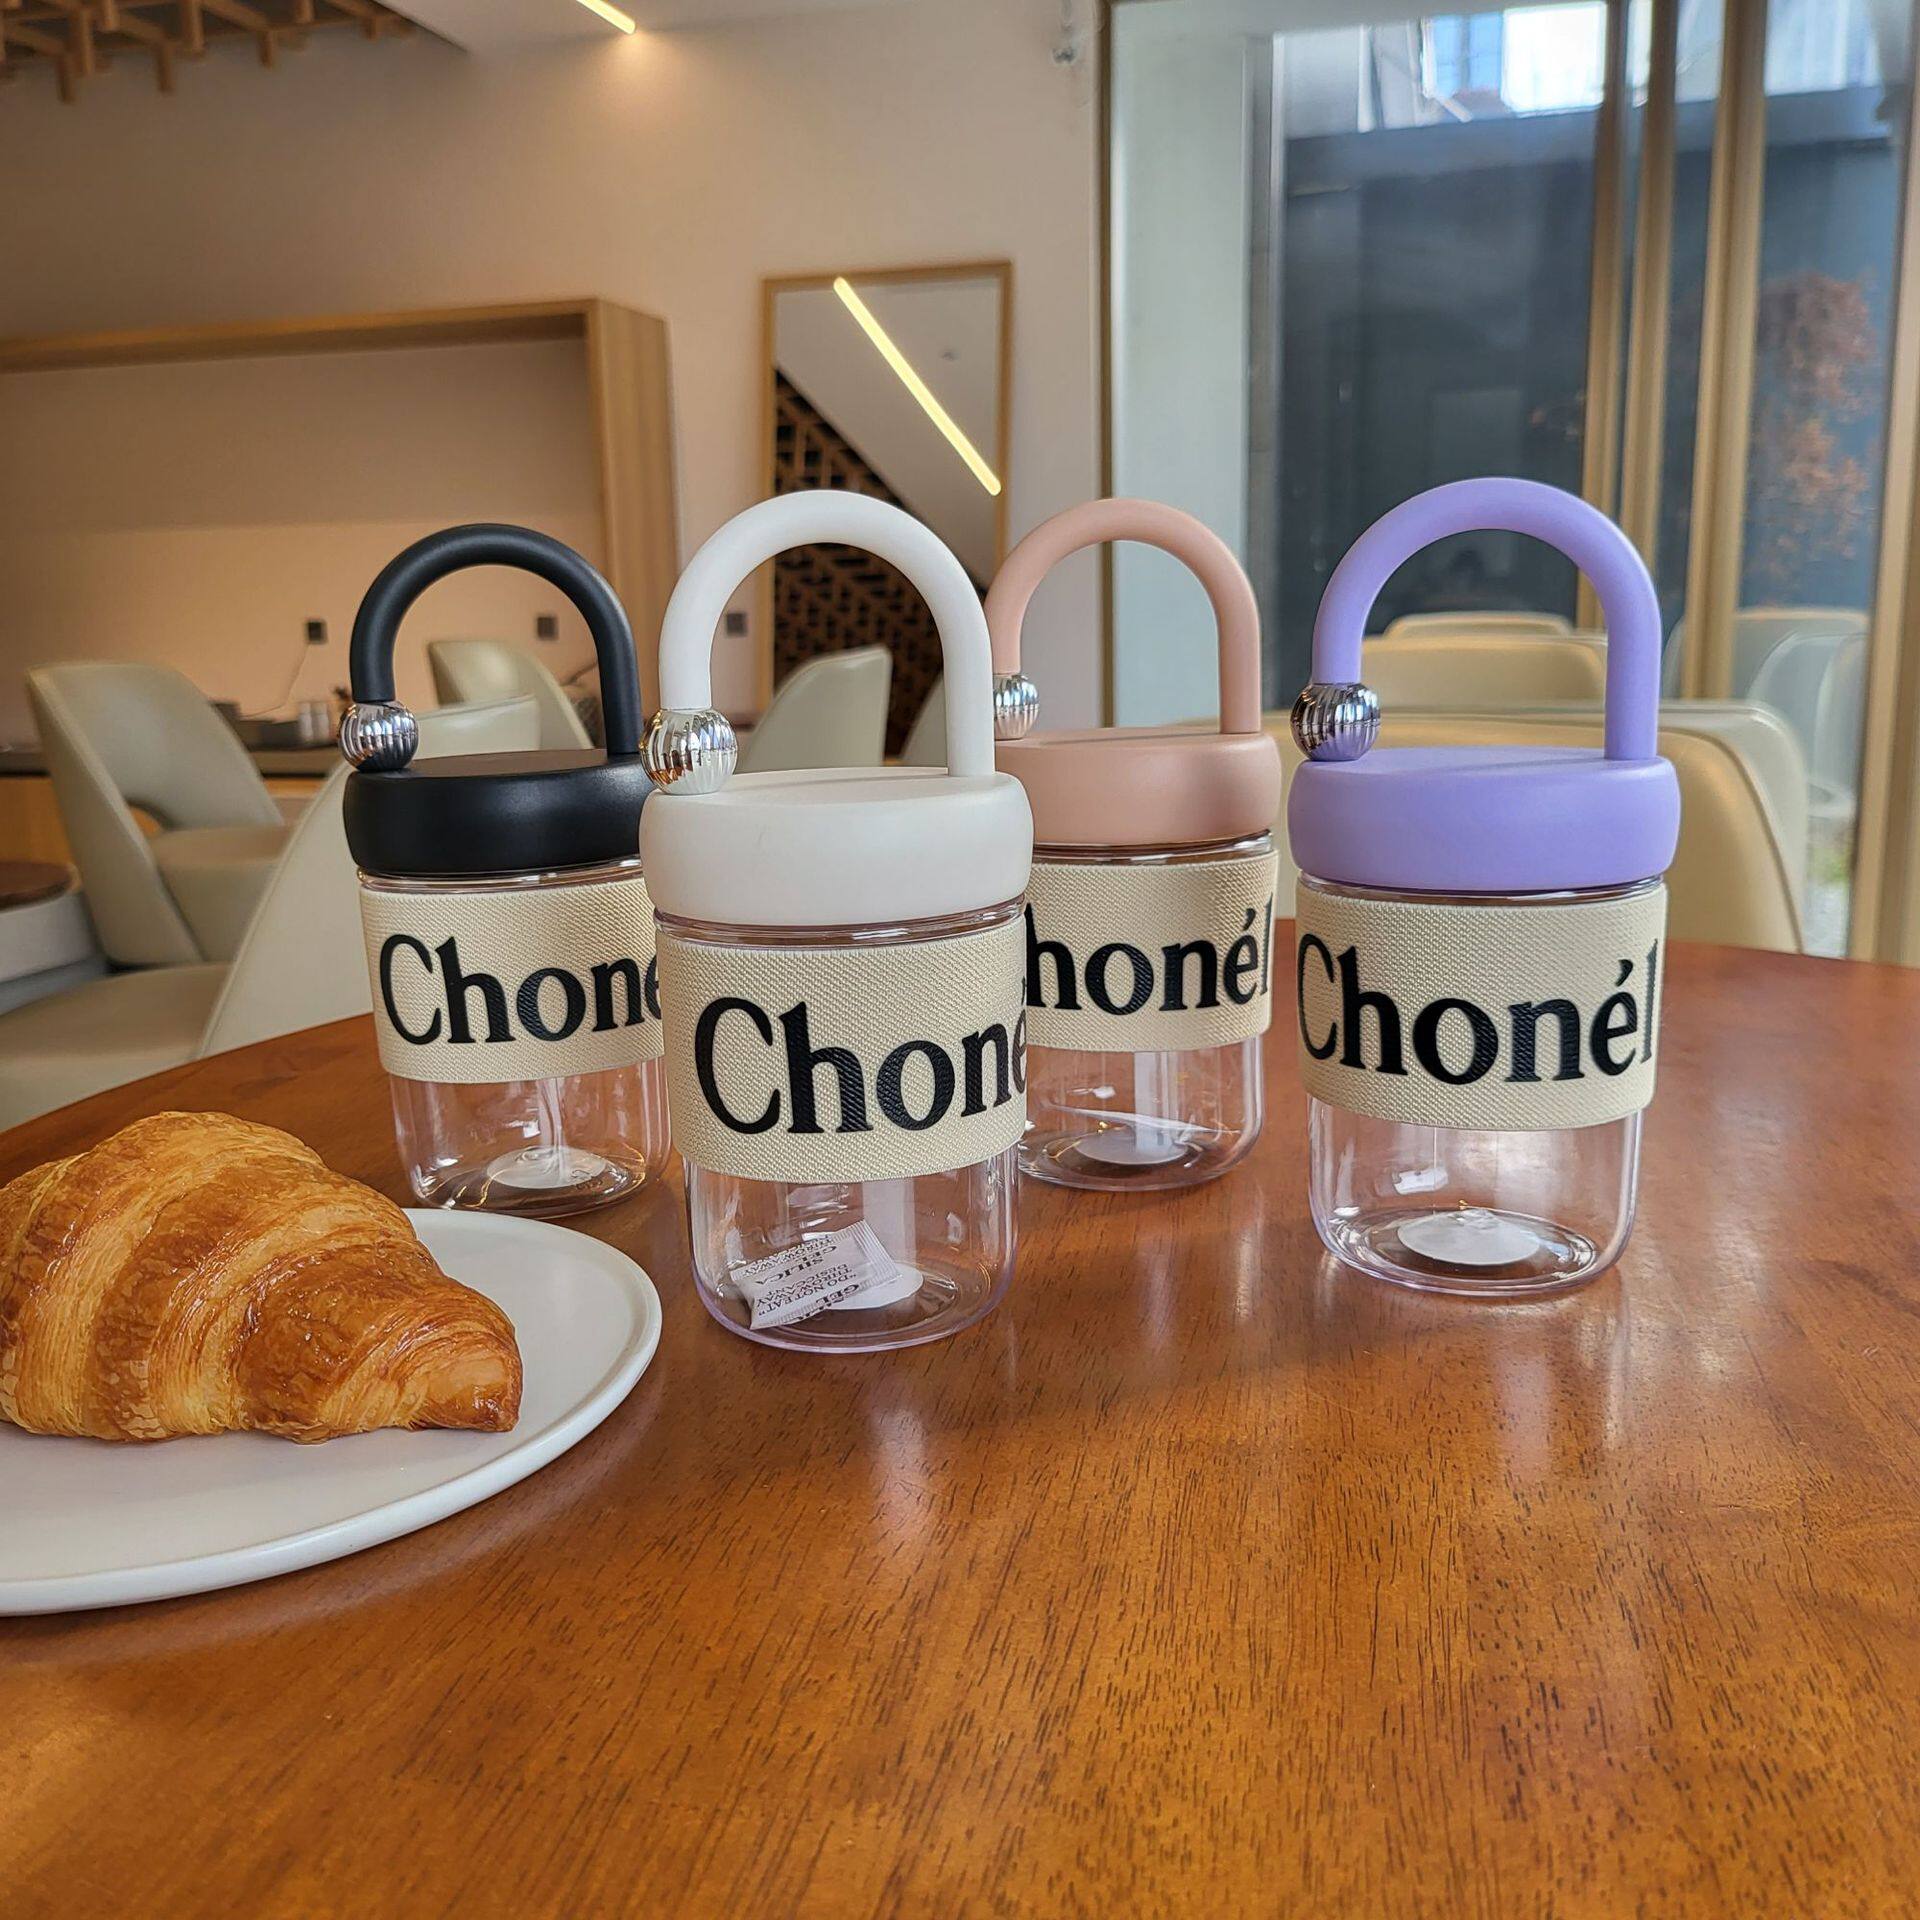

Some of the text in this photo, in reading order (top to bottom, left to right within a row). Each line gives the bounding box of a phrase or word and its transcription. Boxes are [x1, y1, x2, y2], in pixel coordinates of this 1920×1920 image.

[1025, 892, 1273, 1015] honél
[1298, 933, 1658, 1085] Chonél
[755, 1258, 823, 1285] SILICA
[757, 1289, 796, 1308] AWAY
[794, 1284, 825, 1300] NOT
[816, 1284, 859, 1306] GEL
